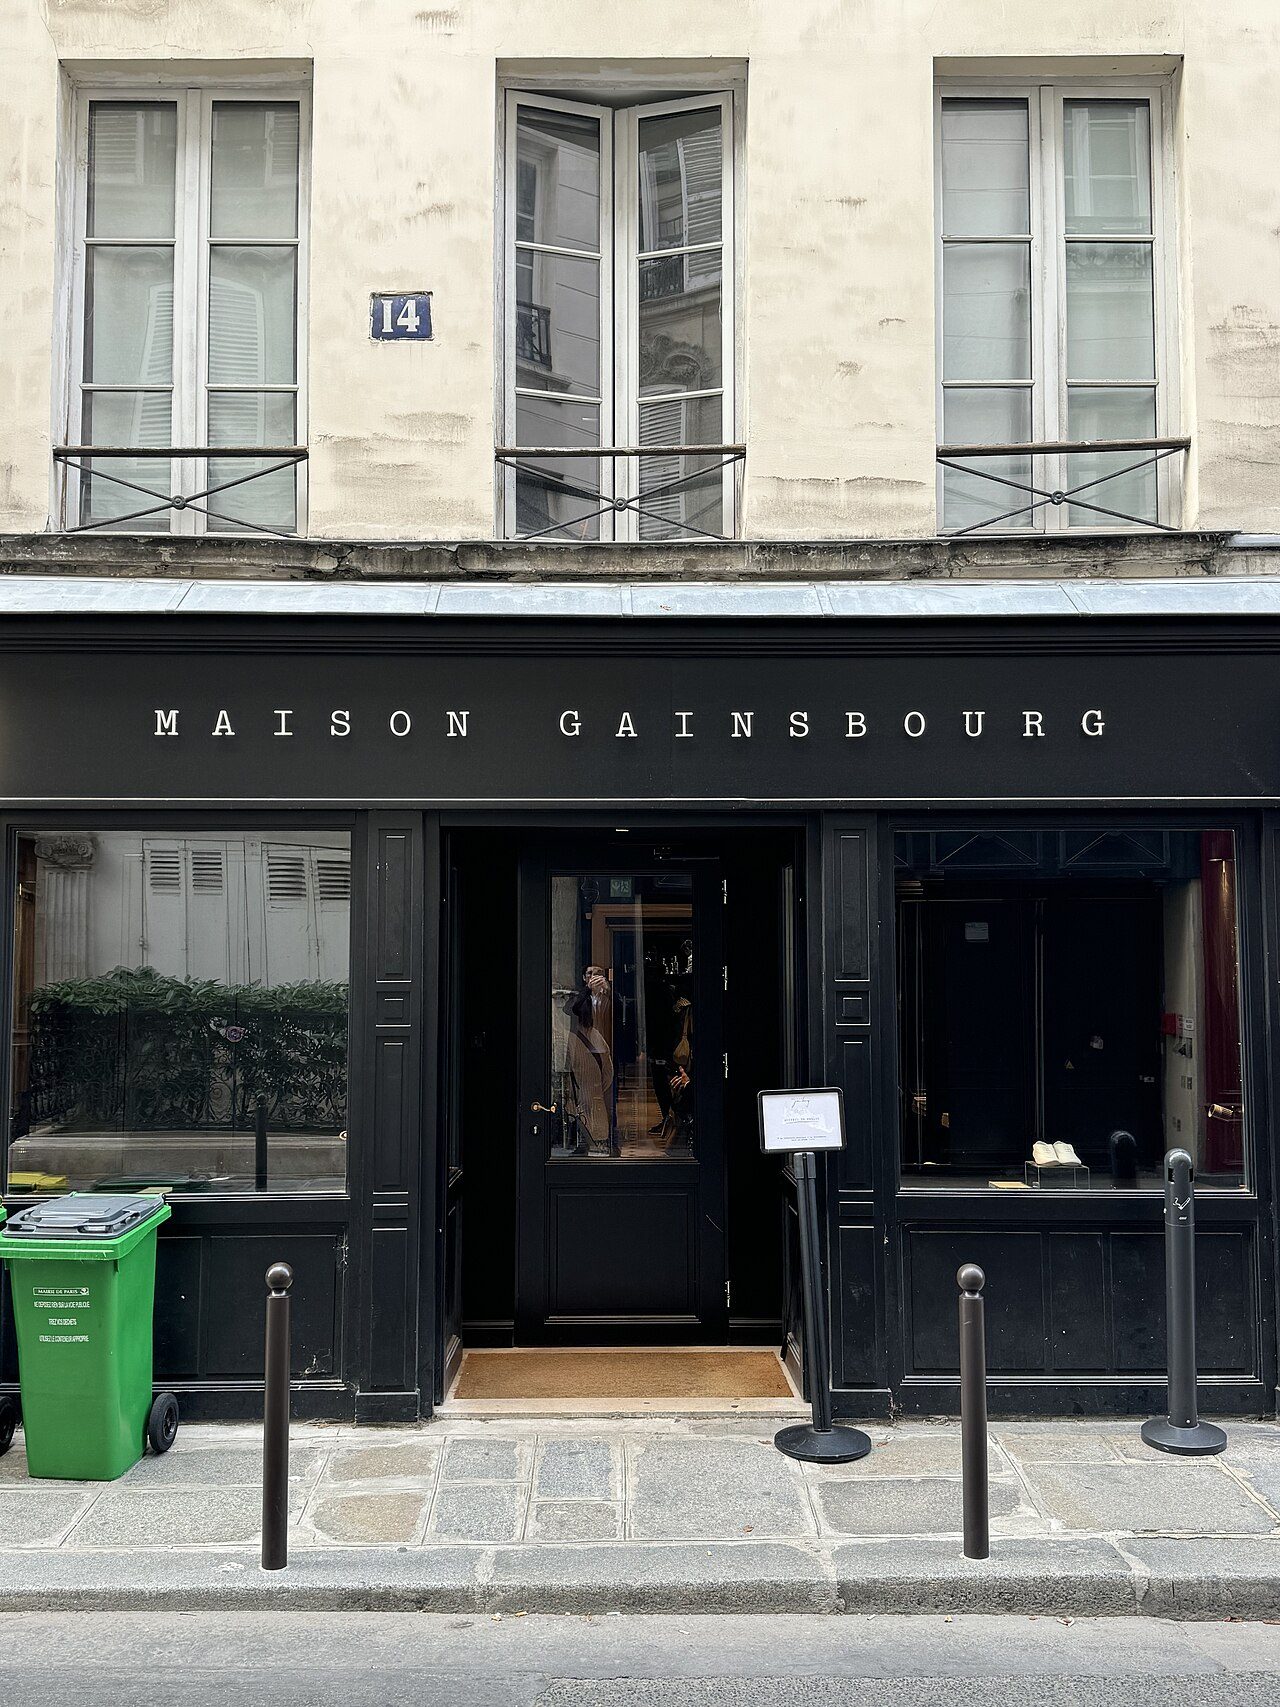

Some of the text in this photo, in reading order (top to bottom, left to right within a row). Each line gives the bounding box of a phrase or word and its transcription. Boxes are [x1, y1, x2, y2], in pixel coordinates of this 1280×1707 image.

[381, 299, 420, 332] 14
[154, 709, 1106, 738] MAISON GAINSBOURG
